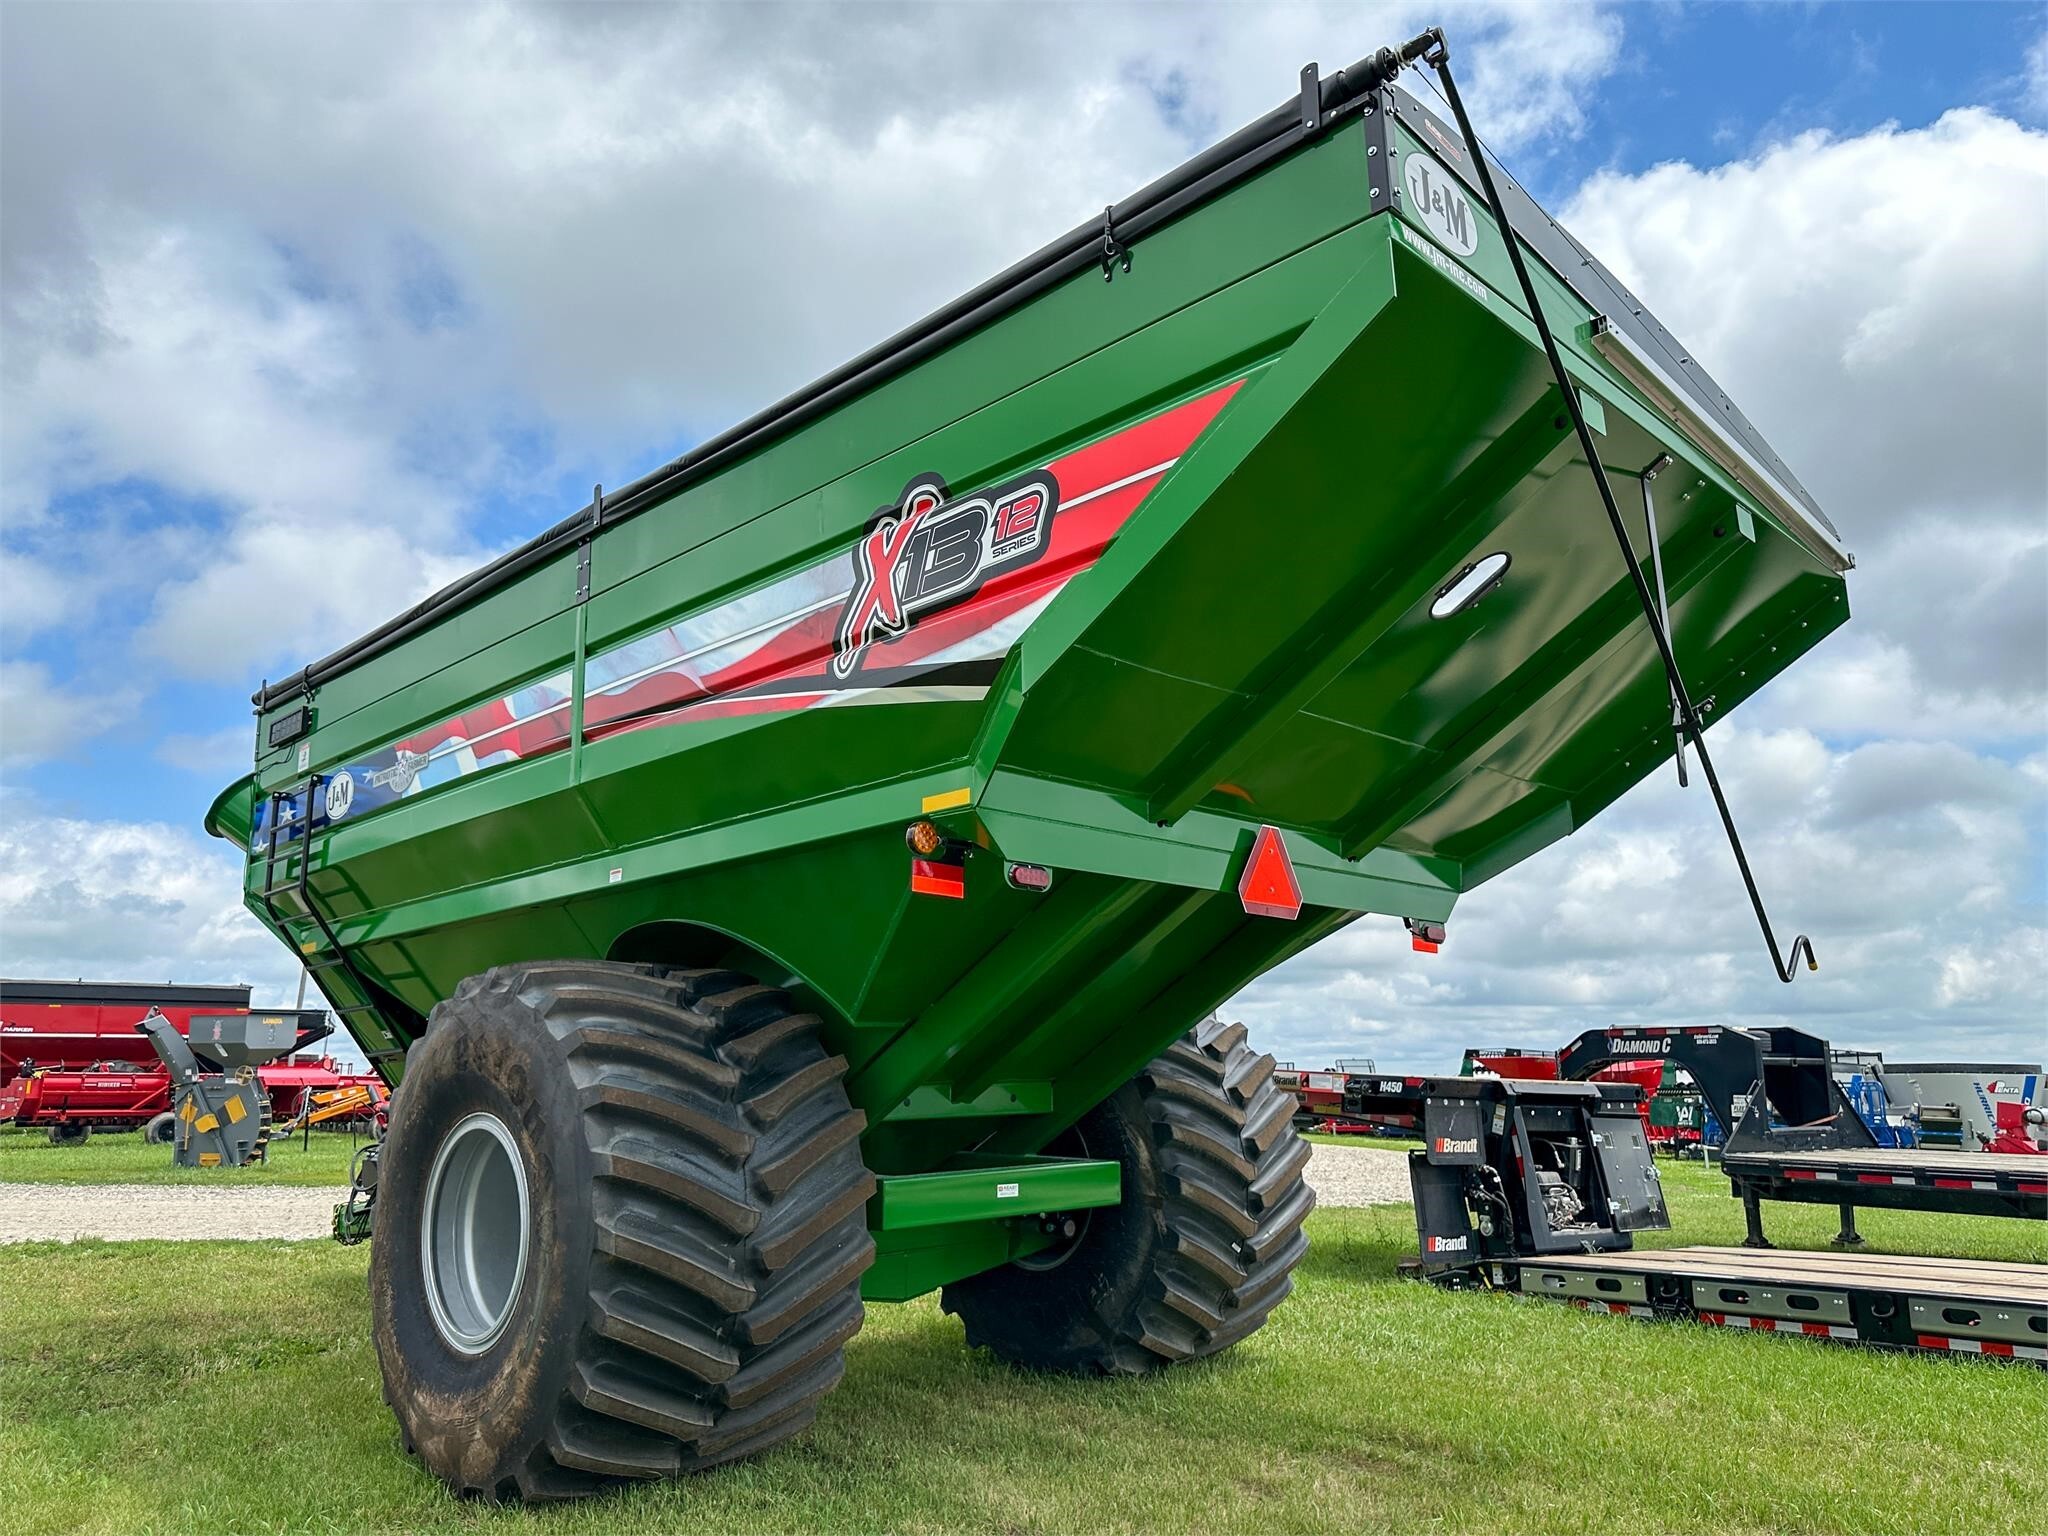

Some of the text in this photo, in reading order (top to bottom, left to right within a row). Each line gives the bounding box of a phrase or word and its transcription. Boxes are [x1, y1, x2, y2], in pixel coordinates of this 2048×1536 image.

[1410, 164, 1470, 249] J&M
[1402, 225, 1488, 301] www.jm-inc.com
[995, 494, 1040, 543] 12
[992, 533, 1036, 558] SERIES
[328, 780, 349, 811] J&M
[1612, 1037, 1671, 1053] DIAMOND C
[1275, 1075, 1297, 1086] Brandt
[1379, 1081, 1403, 1093] H450
[1994, 1081, 2019, 1094] PENTA
[1973, 1082, 2000, 1134] HURRICA
[1443, 1138, 1477, 1153] Brandt
[1435, 1235, 1468, 1252] Brandt
